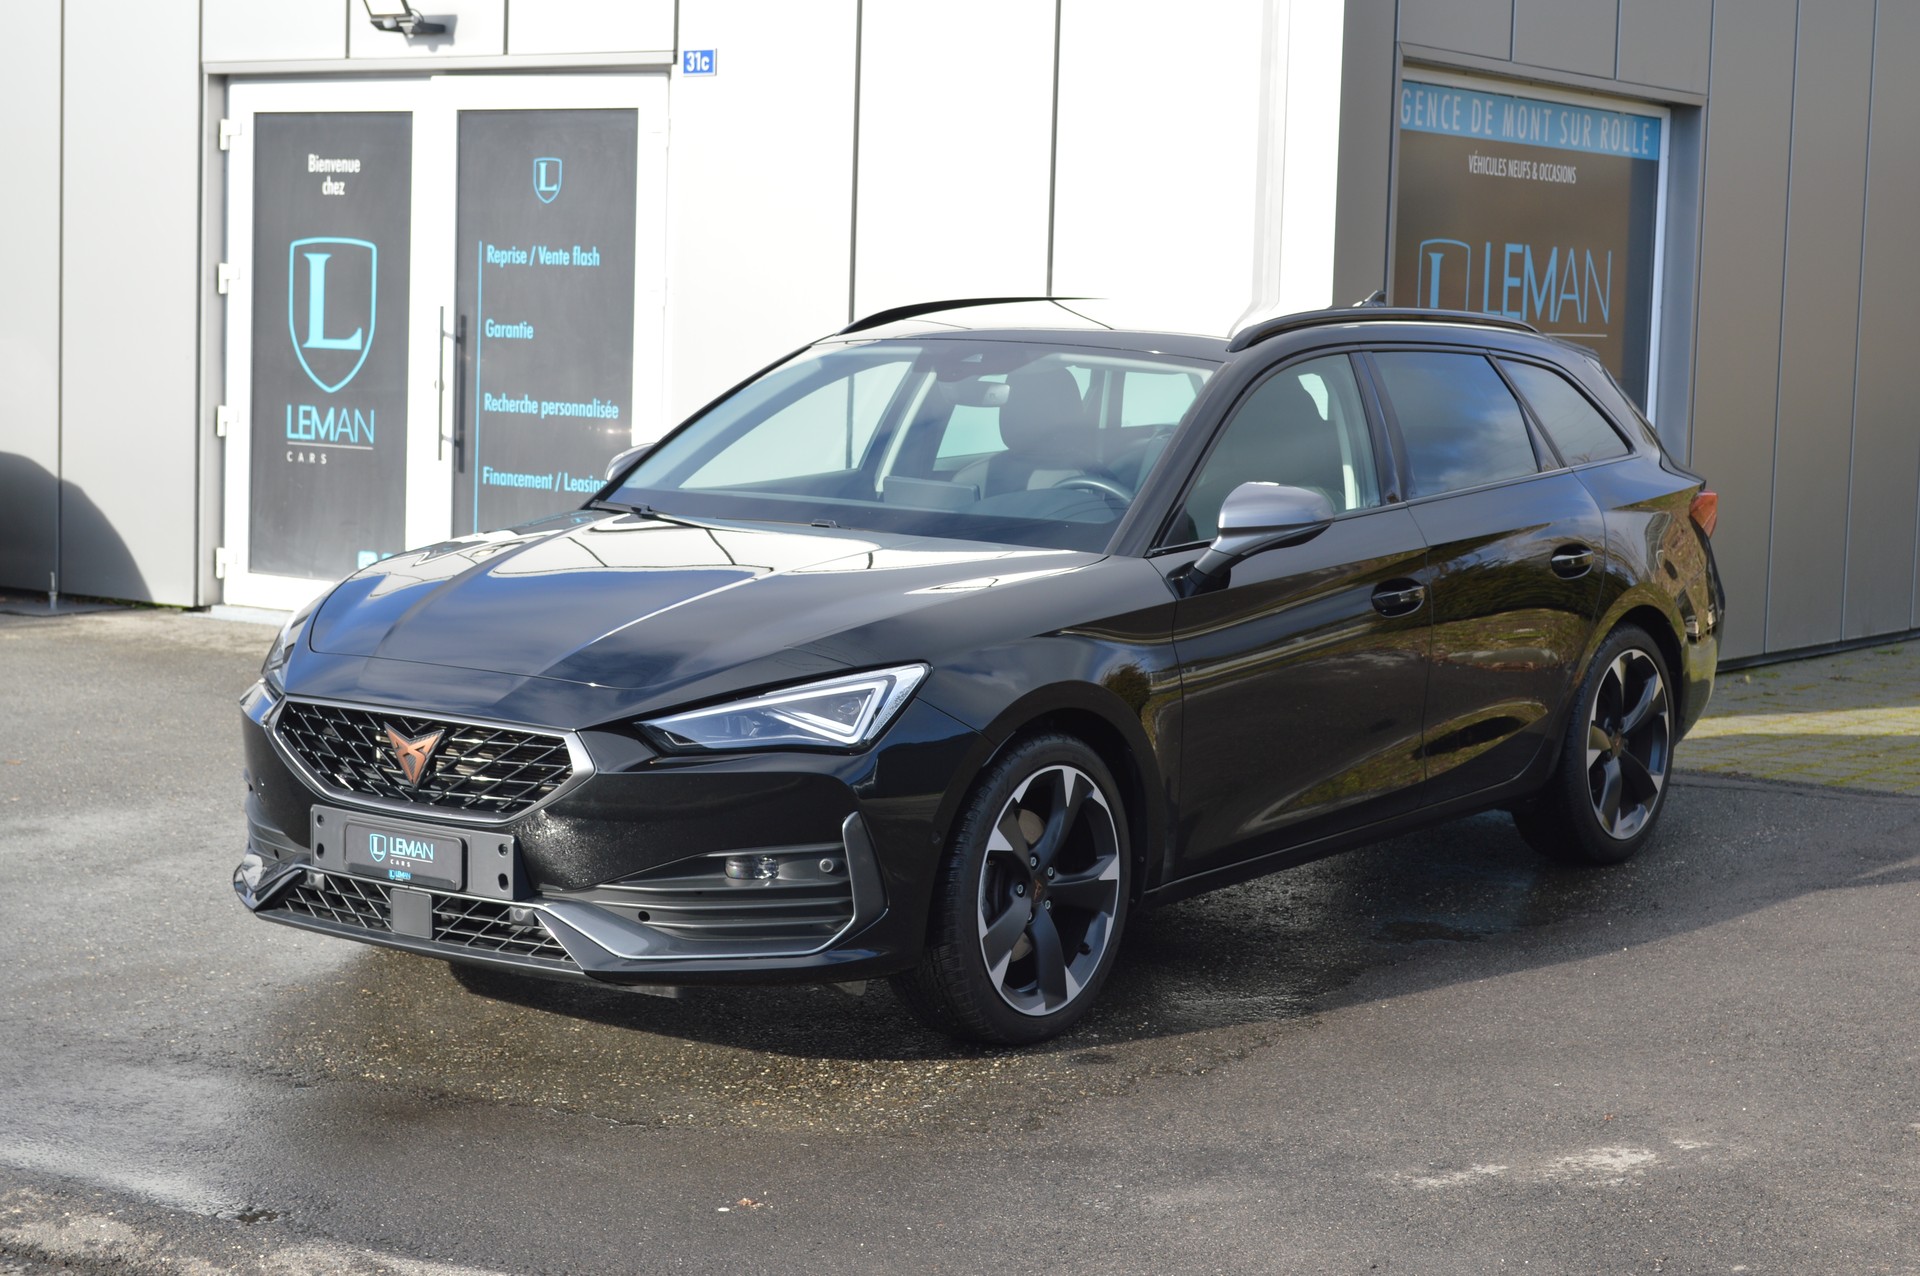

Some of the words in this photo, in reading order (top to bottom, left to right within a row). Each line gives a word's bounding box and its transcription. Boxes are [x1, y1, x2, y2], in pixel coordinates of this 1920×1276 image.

[686, 51, 710, 72] 31c
[1471, 98, 1493, 135] DE
[1502, 103, 1552, 143] MONT
[1560, 111, 1591, 147] SUR
[1600, 117, 1649, 154] ROLLE
[307, 153, 361, 173] Bienvenue
[1468, 150, 1507, 177] VÉHICULES
[1508, 159, 1531, 179] NEUFS
[1532, 162, 1538, 180] &
[1539, 163, 1576, 184] OCCASIONS
[322, 175, 345, 195] chez
[539, 162, 557, 191] L
[486, 244, 528, 268] Reprise
[529, 245, 536, 266] /
[538, 245, 570, 265] Vente
[572, 245, 600, 266] flash
[1483, 241, 1612, 324] LEMAN
[302, 253, 362, 350] L
[485, 318, 534, 339] Garantie
[484, 392, 538, 414] Recherche
[540, 398, 619, 419] personnalisée
[286, 404, 375, 444] LEMAN
[286, 451, 327, 465] CARS
[482, 465, 553, 489] Financement
[554, 472, 562, 492] /
[373, 836, 384, 855] L
[390, 836, 433, 860] LEMAN
[390, 858, 411, 868] CARS
